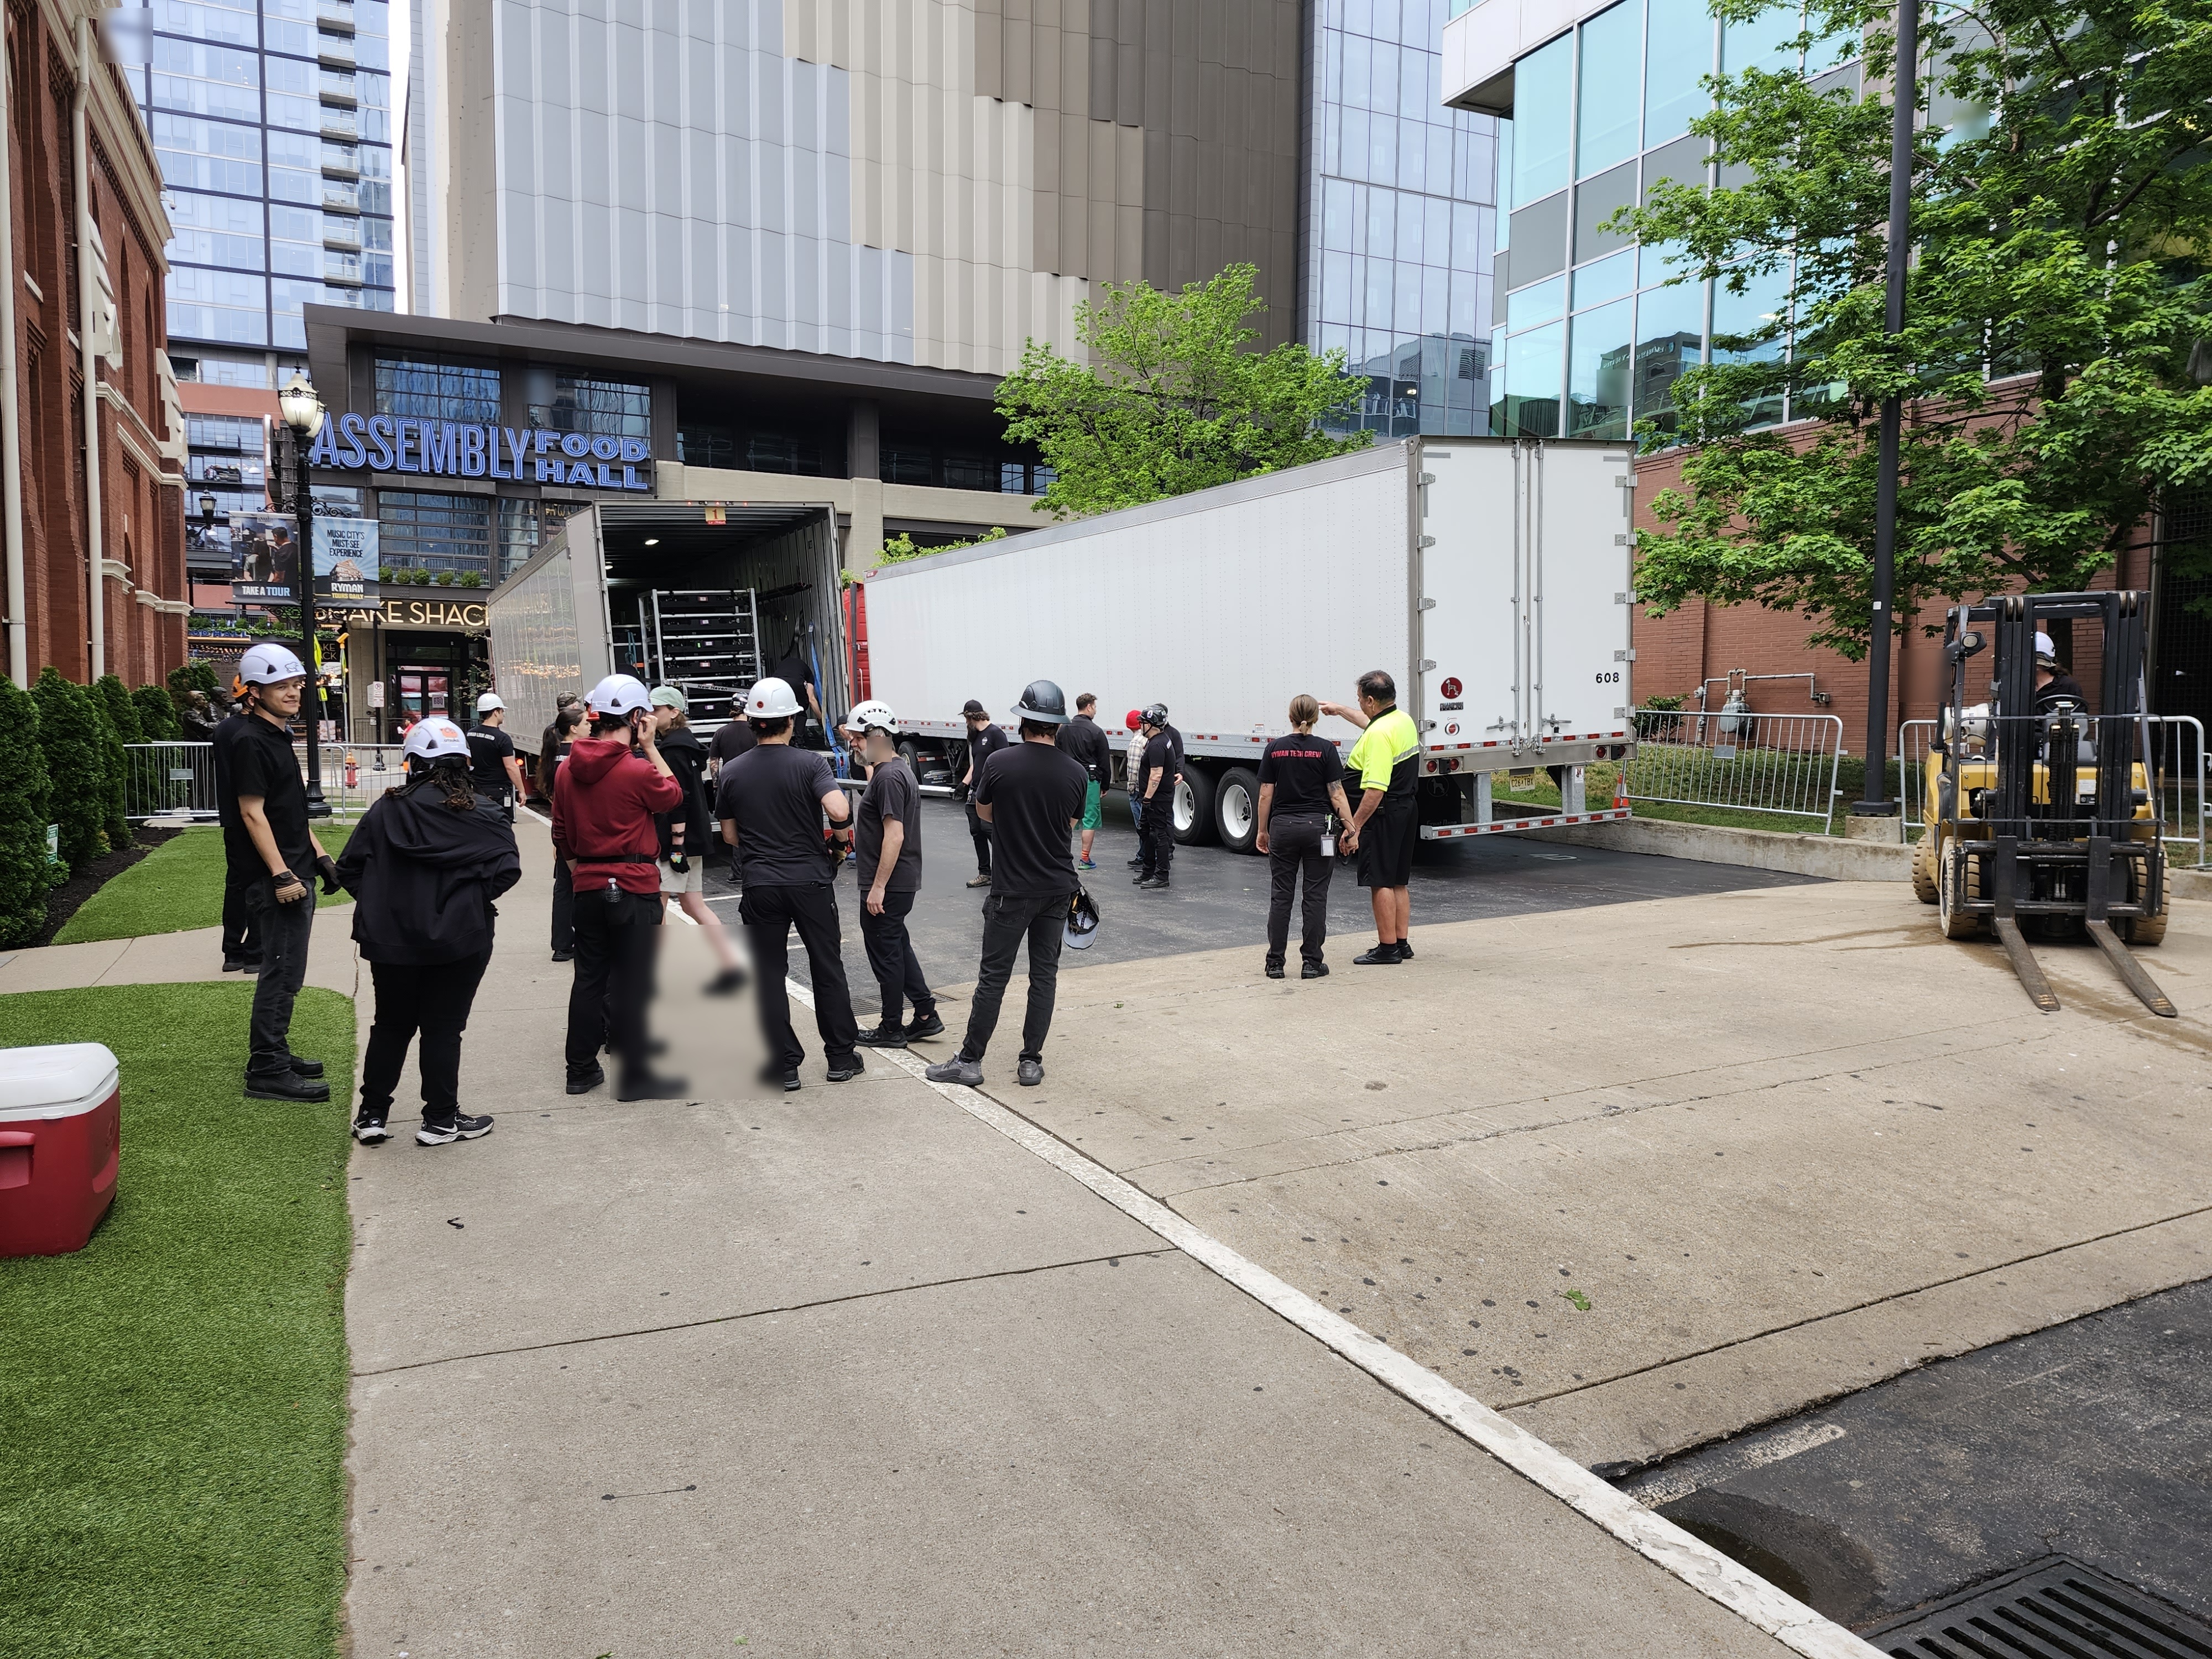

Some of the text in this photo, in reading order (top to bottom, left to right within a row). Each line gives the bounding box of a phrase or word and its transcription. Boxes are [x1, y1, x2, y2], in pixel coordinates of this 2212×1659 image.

[312, 411, 648, 480] ASSEMBLY FOOD
[535, 458, 648, 490] HALL
[712, 509, 718, 519] 1
[327, 529, 365, 540] MUSIC CITY'S
[332, 539, 360, 549] MUST-SEE
[329, 548, 363, 558] EXPERIENCE
[242, 586, 291, 597] TAKE A TOUR
[331, 582, 364, 593] RYMAN
[1596, 672, 1619, 684] 608
[1271, 750, 1289, 758] RYMAN
[1511, 777, 1533, 787] C26 TBX
